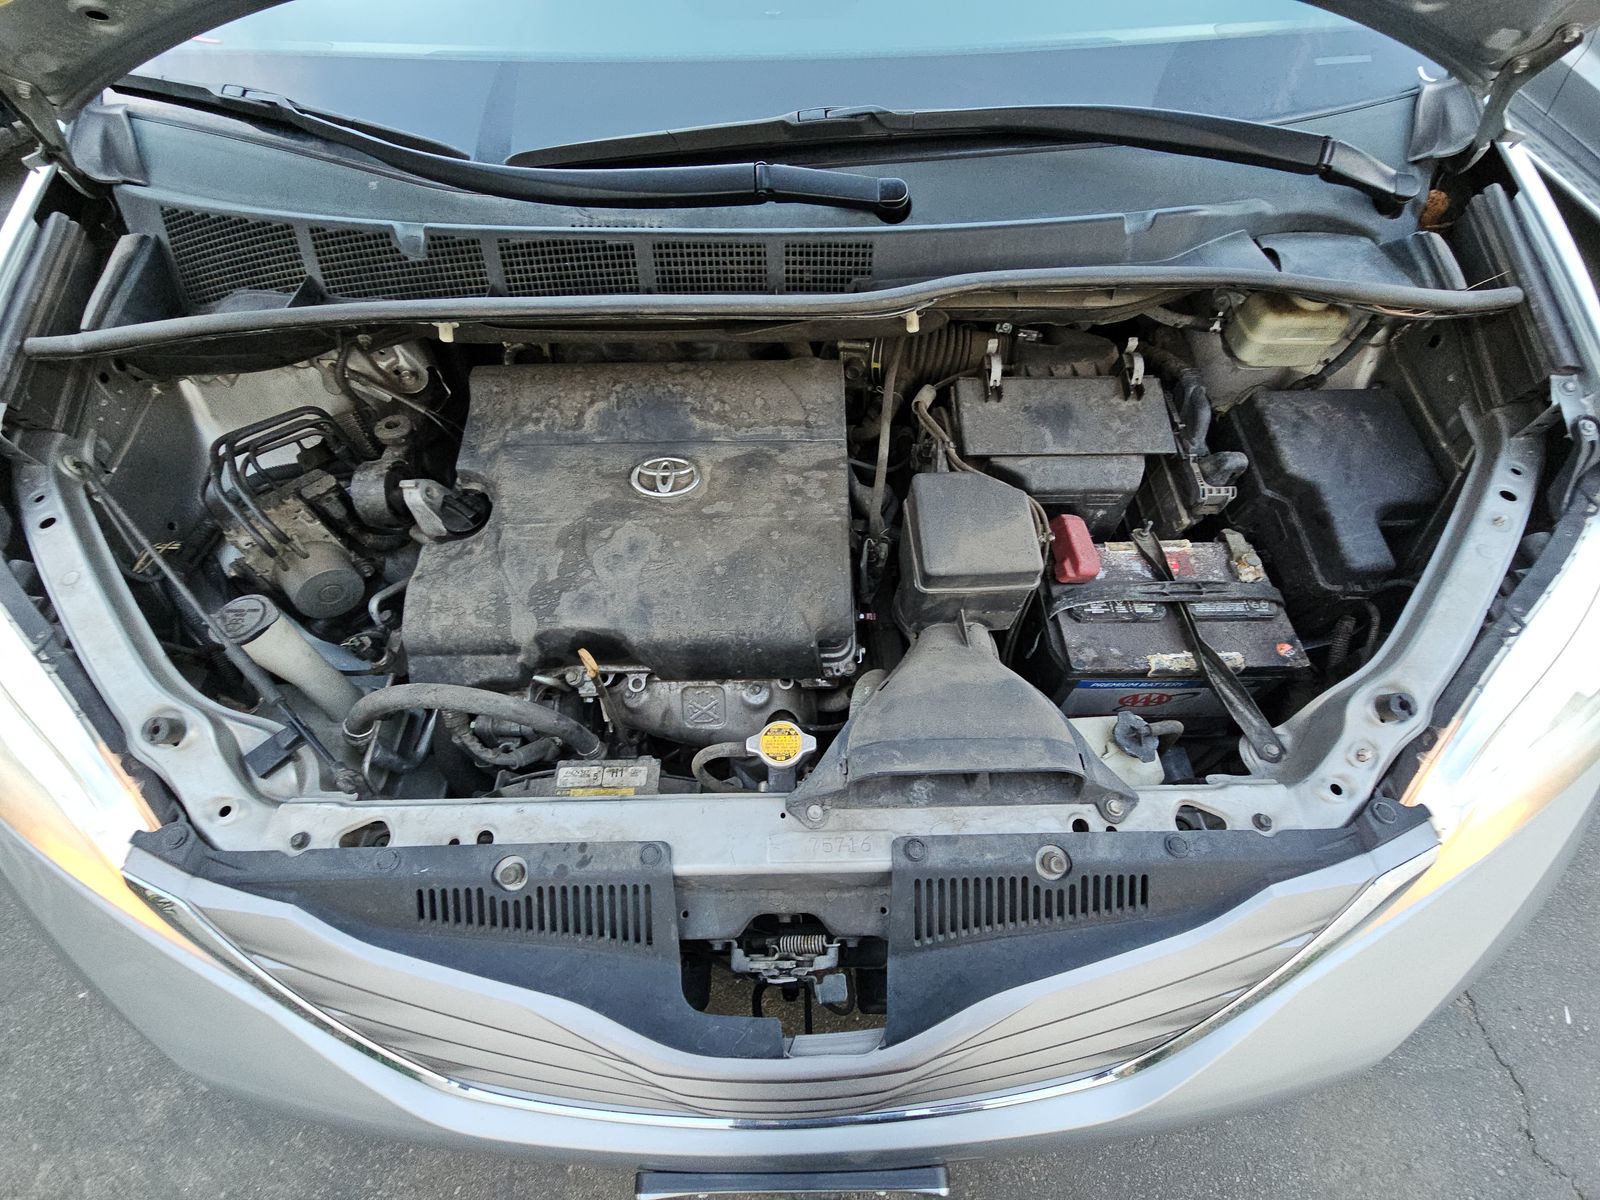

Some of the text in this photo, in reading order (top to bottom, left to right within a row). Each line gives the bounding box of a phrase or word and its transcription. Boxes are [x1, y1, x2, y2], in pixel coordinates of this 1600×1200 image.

[1138, 681, 1185, 689] BATTERY
[1120, 693, 1171, 707] AAA
[808, 835, 872, 854] 75716
